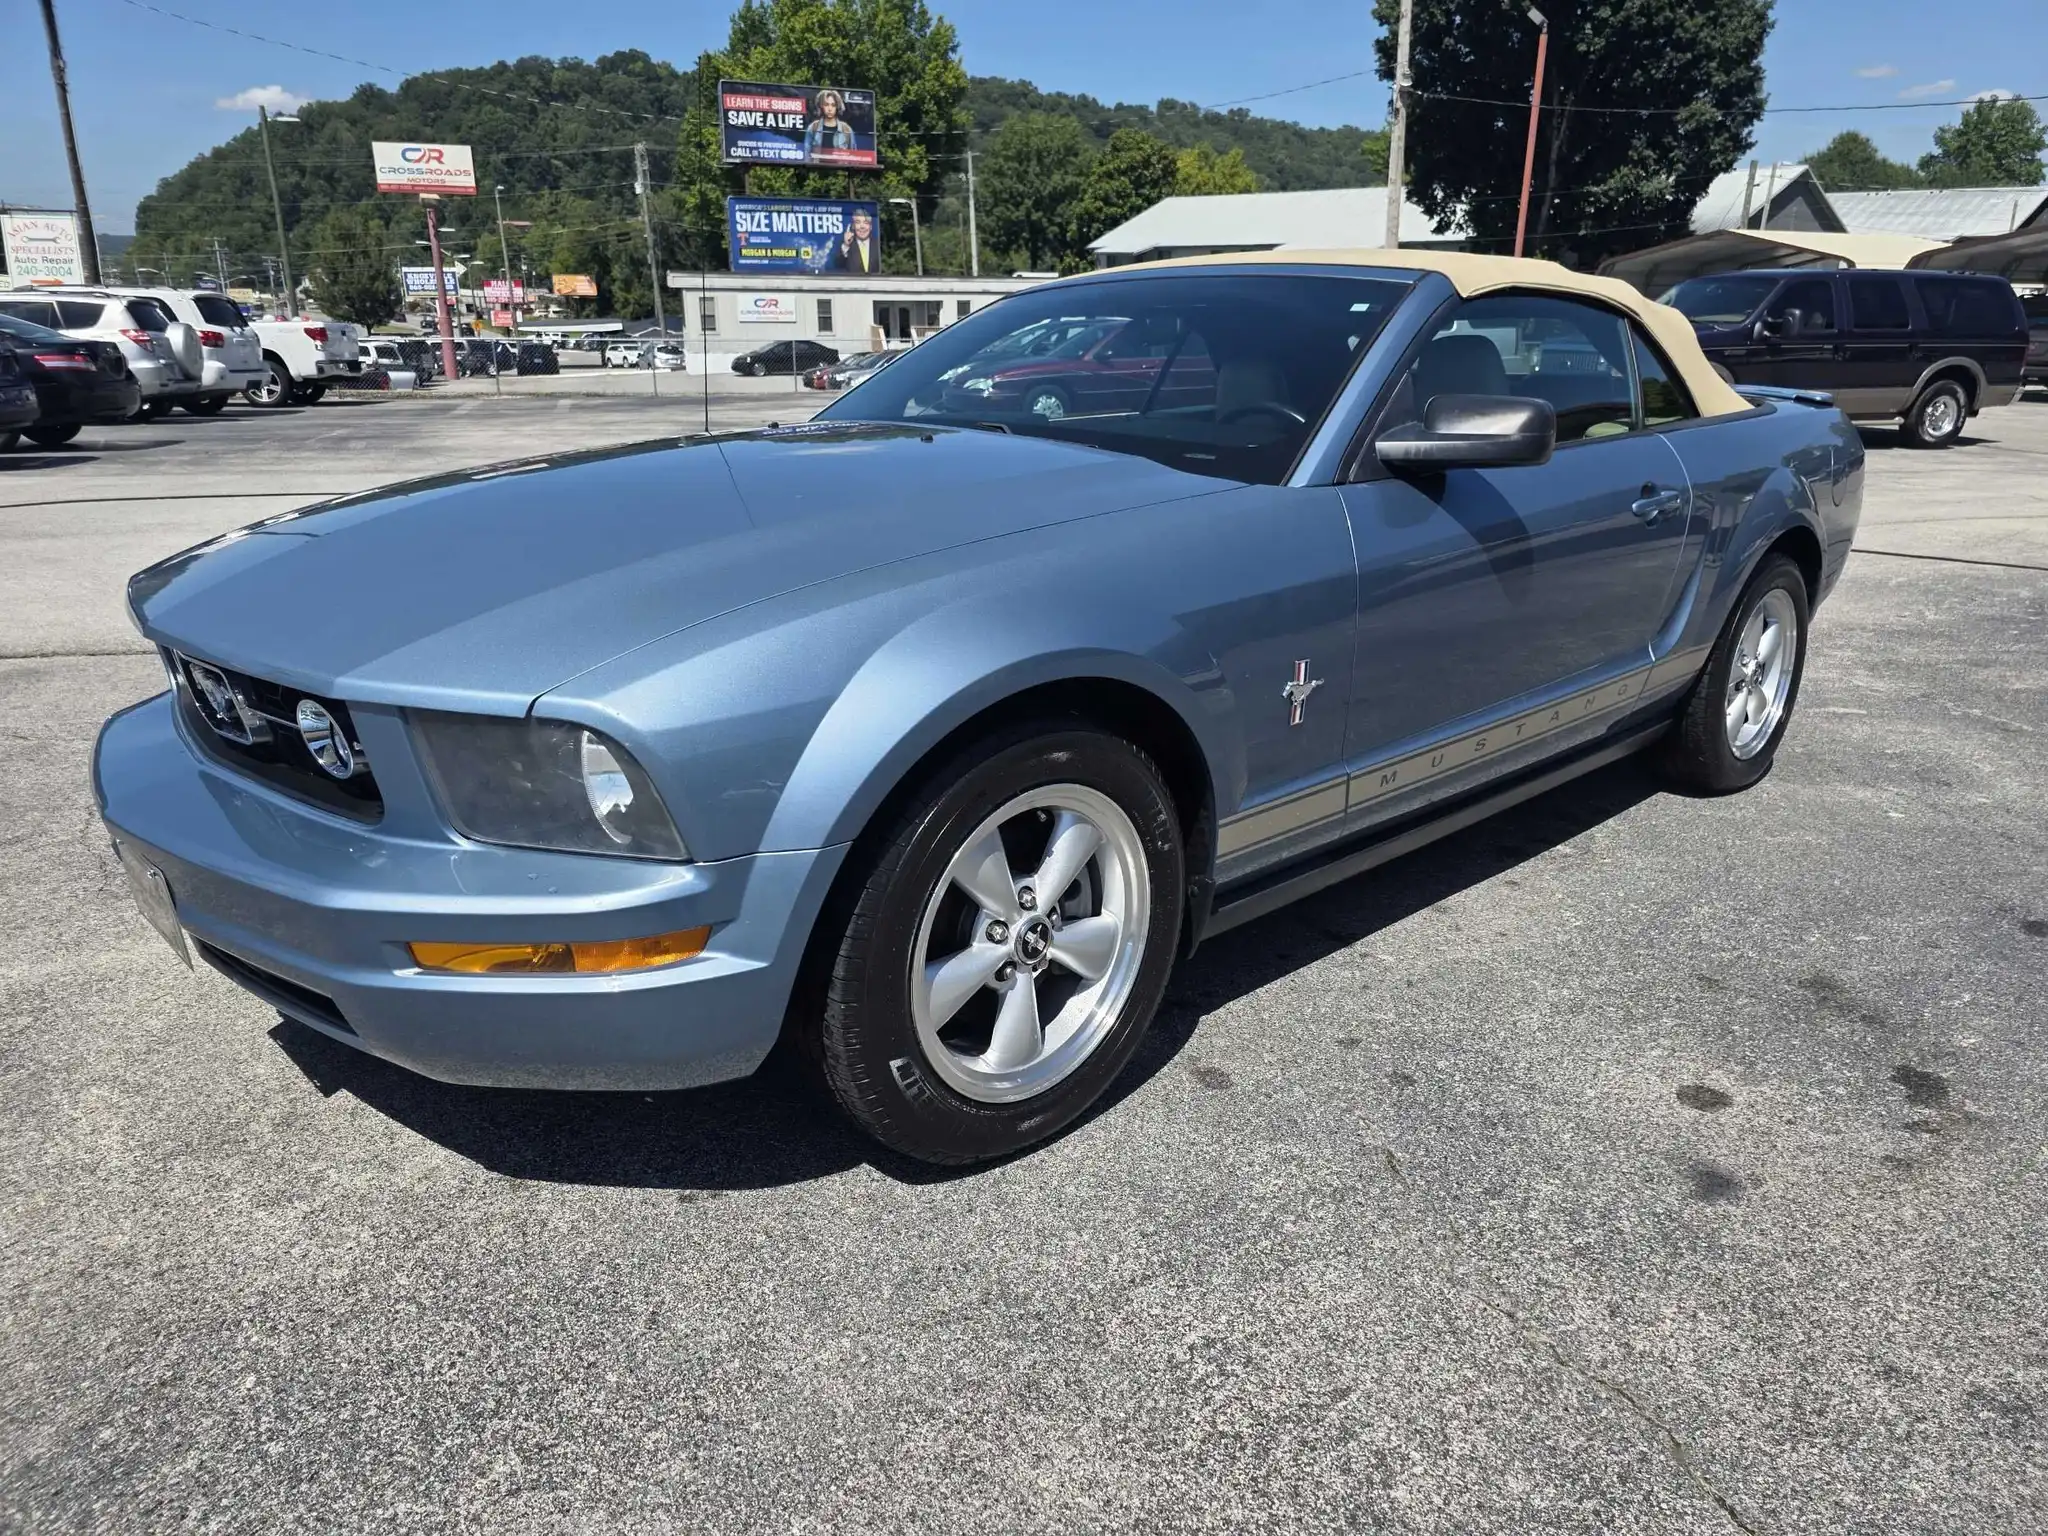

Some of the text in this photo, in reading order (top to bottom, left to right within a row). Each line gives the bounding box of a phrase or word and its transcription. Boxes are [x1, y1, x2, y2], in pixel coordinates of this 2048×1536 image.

[726, 97, 803, 111] LEARN THE SIGNS
[728, 110, 804, 129] SAVE A LIFE
[730, 147, 752, 157] CALL
[759, 148, 780, 158] TEXT
[379, 166, 472, 177] CROSSROADS
[735, 211, 843, 234] SIZE MATTERS
[7, 220, 73, 242] ASIAN AUTO
[11, 246, 75, 255] SPECIALISTS
[741, 249, 766, 257] MORGAN
[771, 249, 797, 257] MORGAN
[14, 256, 74, 265] Auto Repair
[17, 266, 73, 277] 240-3004
[1380, 683, 1629, 788] MUSTANG
